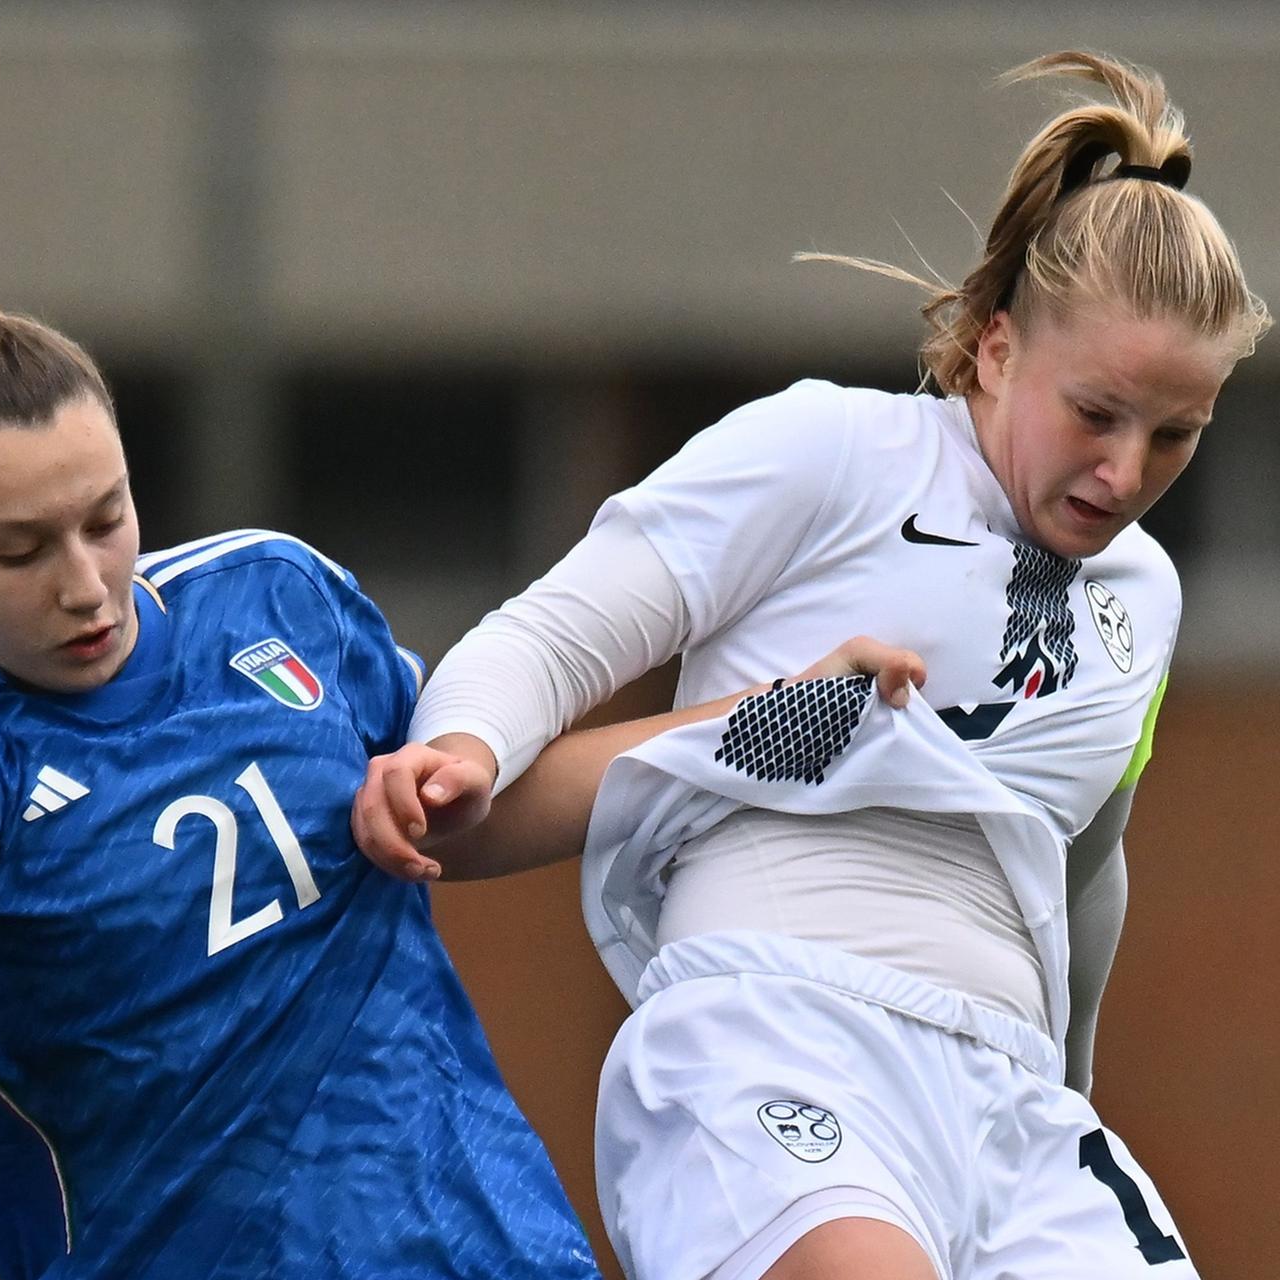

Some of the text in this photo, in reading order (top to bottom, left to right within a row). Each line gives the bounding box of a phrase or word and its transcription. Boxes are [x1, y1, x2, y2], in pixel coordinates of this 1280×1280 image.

[236, 642, 286, 672] ITALIA
[152, 760, 322, 958] 21
[1078, 1127, 1187, 1267] 1
